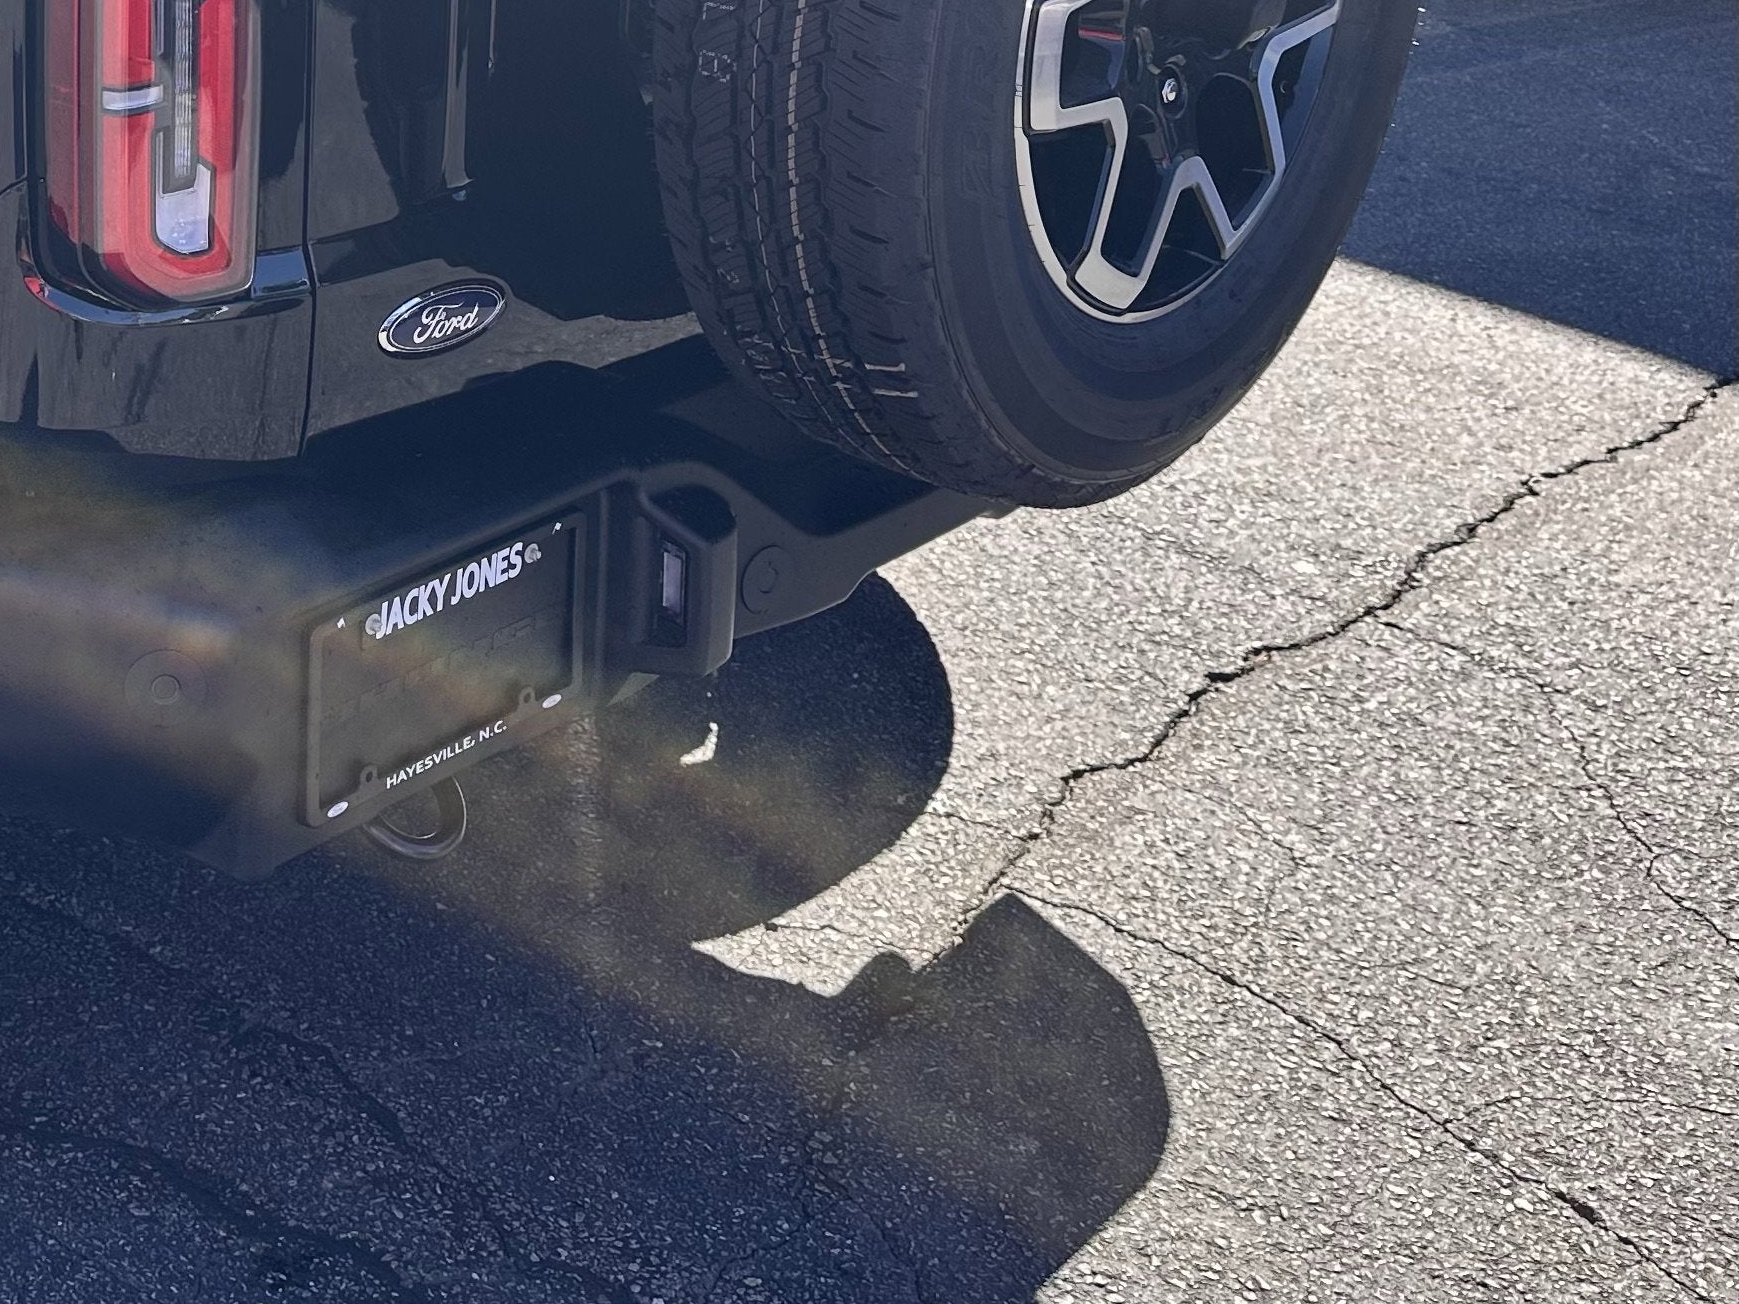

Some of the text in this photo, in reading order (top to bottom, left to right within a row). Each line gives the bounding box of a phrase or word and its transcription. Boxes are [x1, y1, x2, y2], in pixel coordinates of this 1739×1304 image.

[412, 300, 480, 344] Ford
[375, 541, 524, 639] JACKY JONES
[386, 719, 507, 790] HAYESVILLE, N.C.
